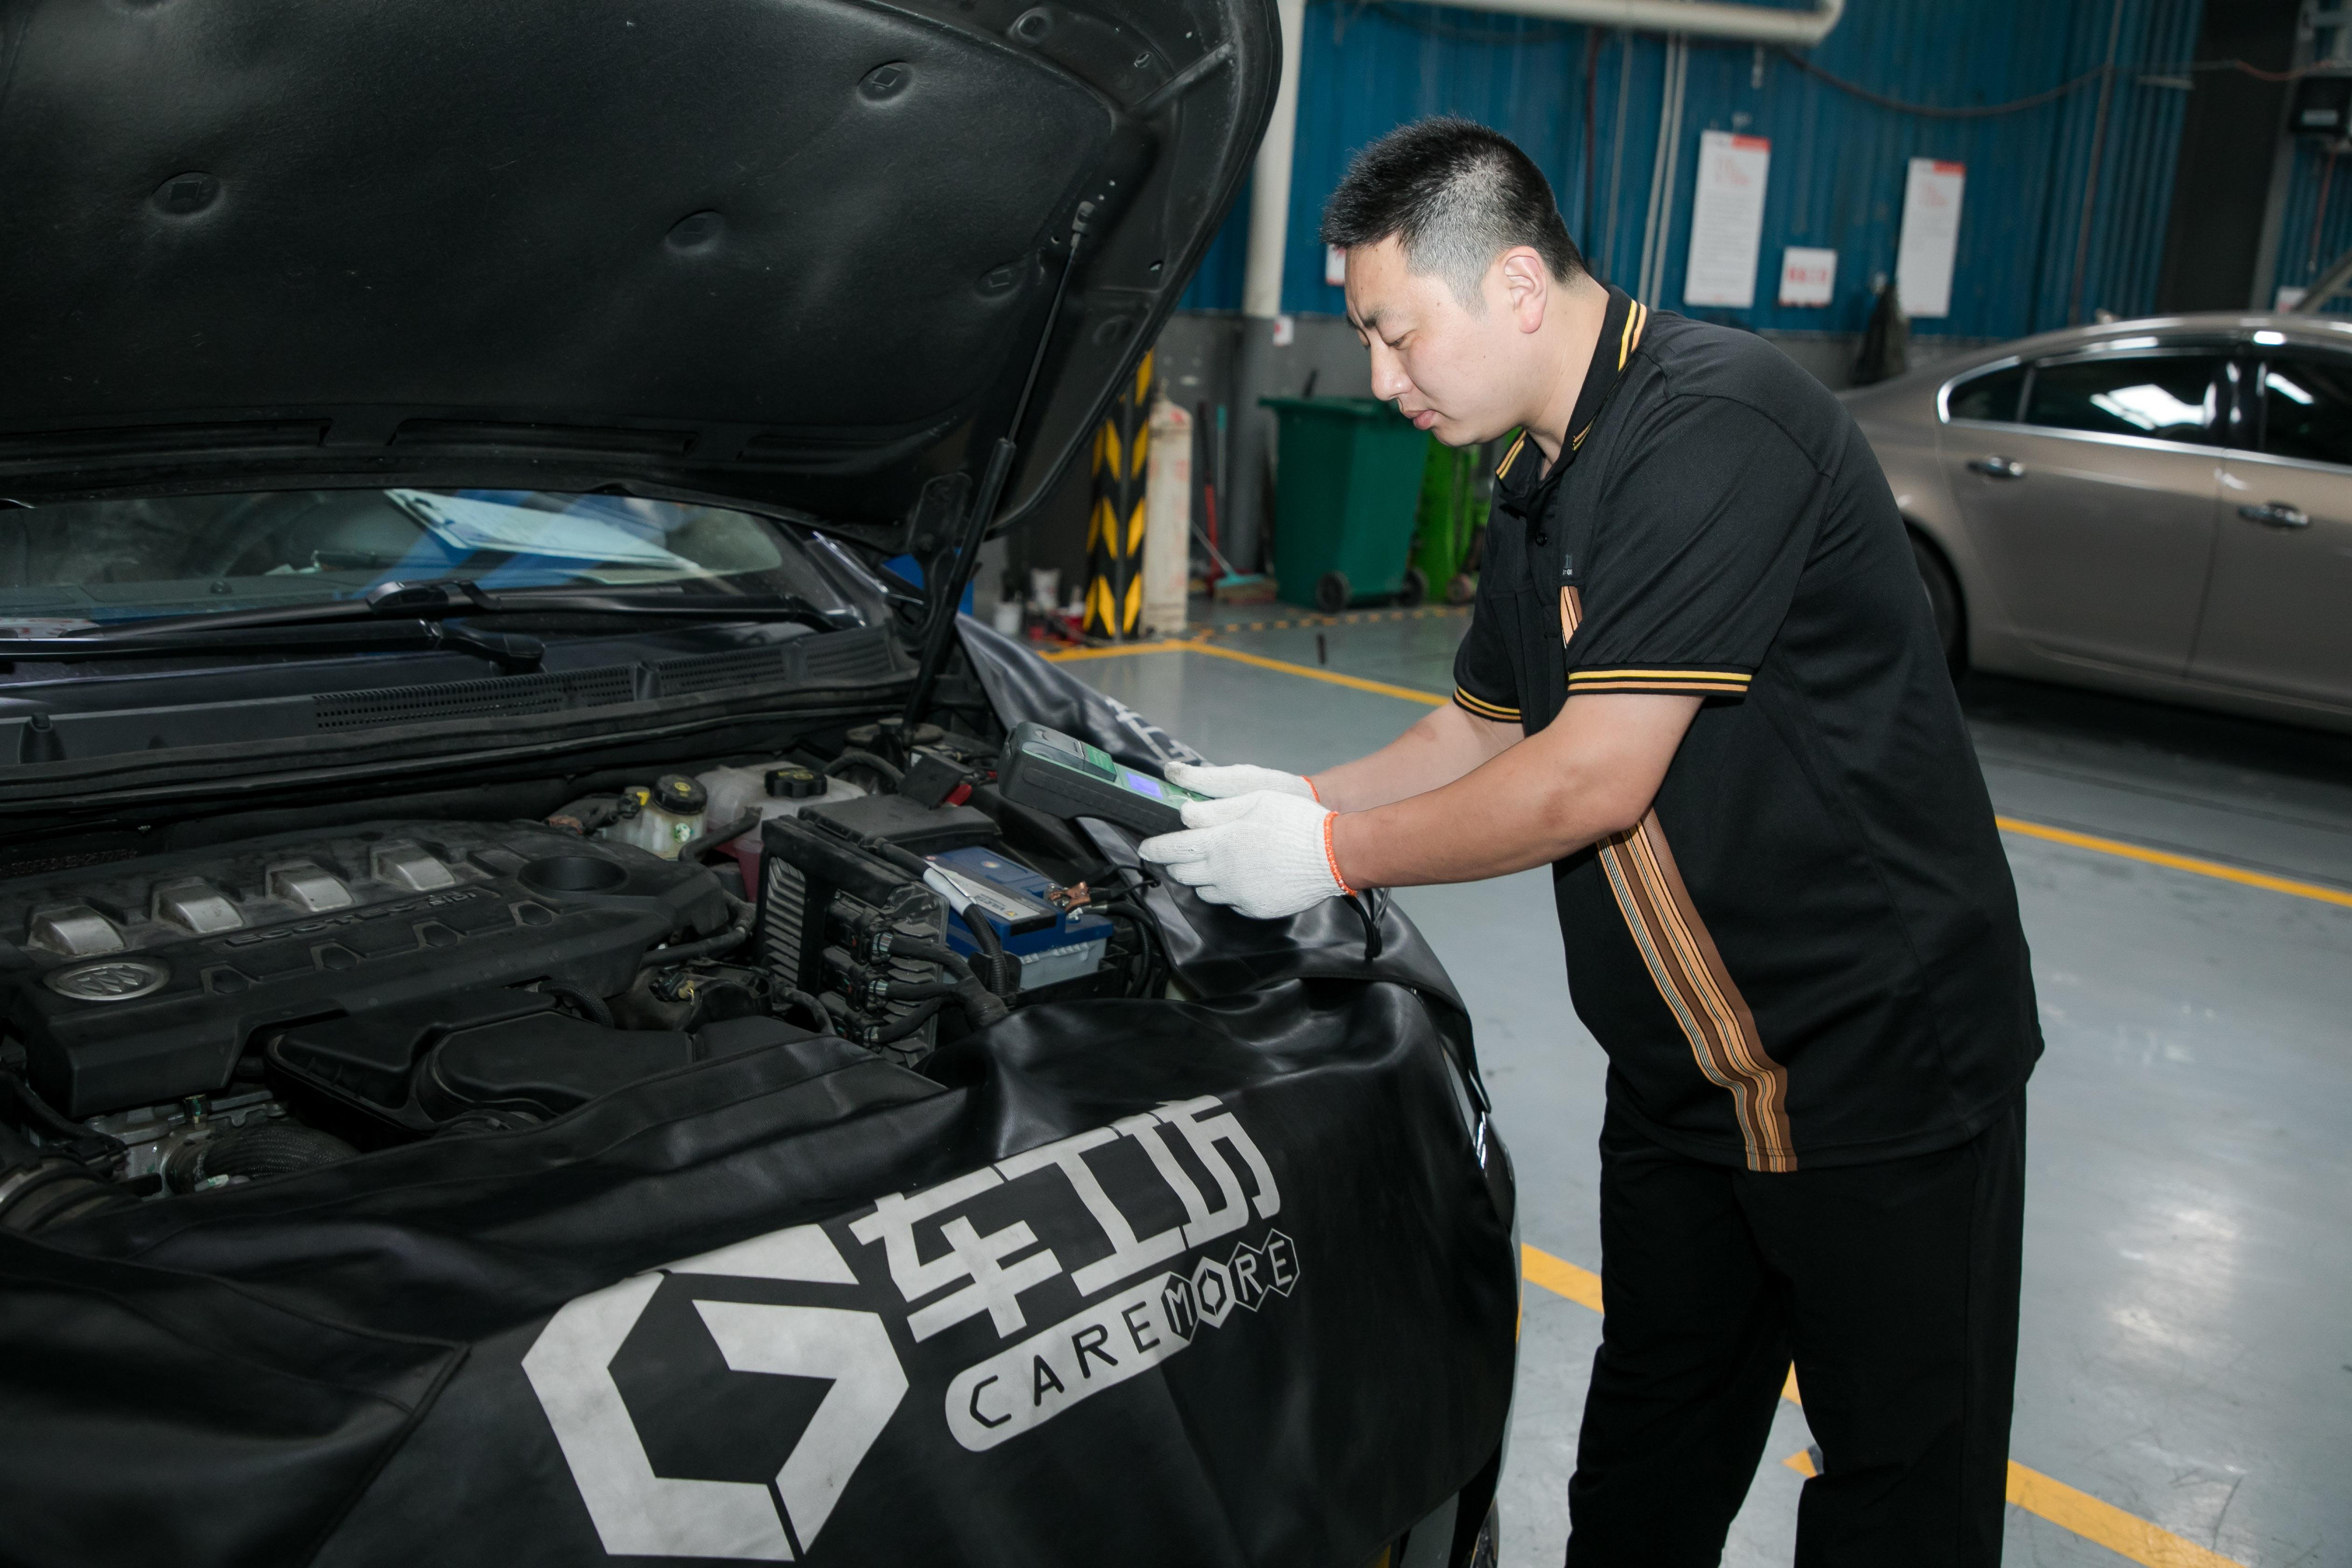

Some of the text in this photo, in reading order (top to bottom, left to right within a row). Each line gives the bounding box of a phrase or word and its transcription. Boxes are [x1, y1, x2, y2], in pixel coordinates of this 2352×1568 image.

[848, 1095, 1281, 1343] 车工坊
[970, 1239, 1293, 1428] CAREMORE
